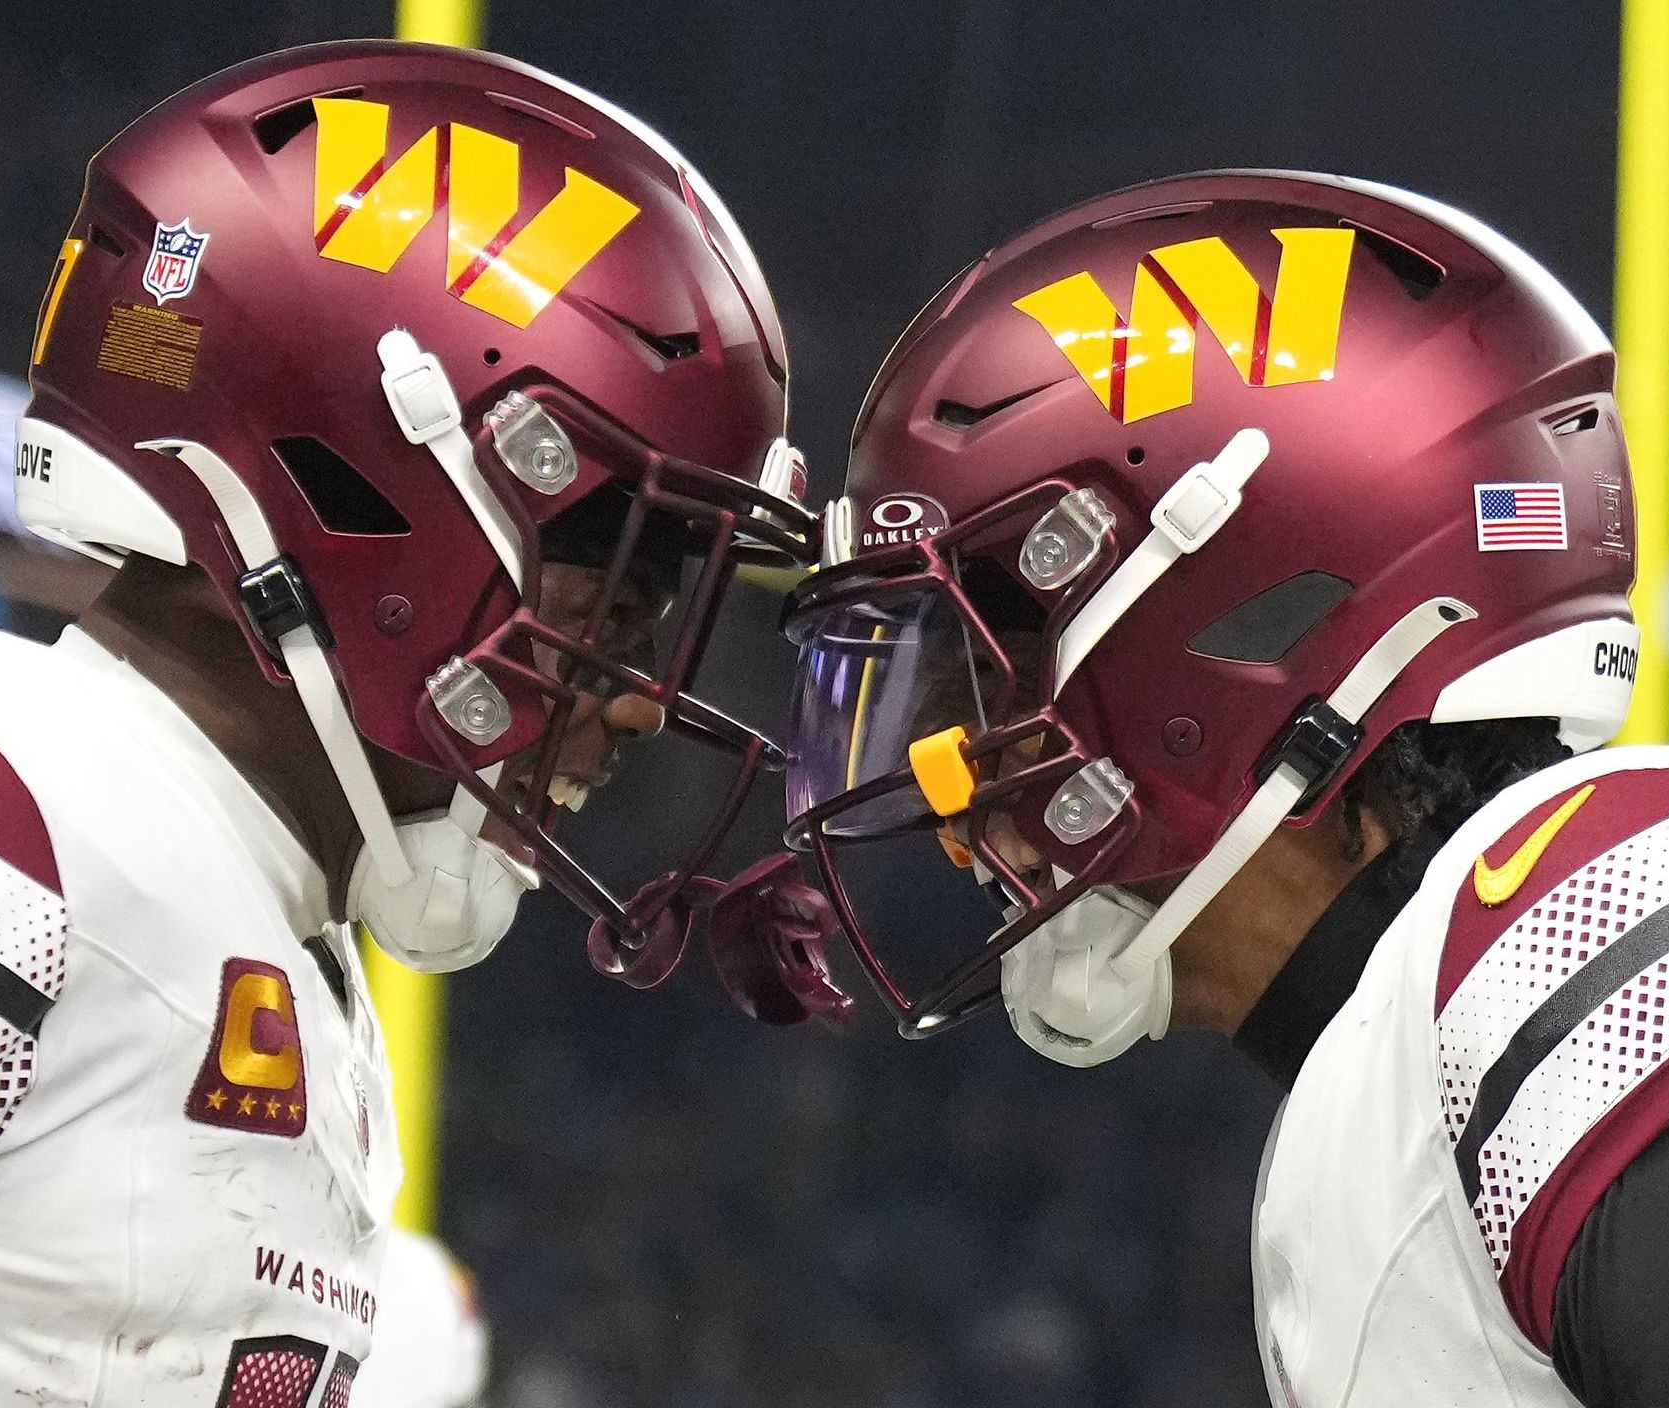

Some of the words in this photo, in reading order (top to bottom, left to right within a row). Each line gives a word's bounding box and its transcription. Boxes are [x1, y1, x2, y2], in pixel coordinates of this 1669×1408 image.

[149, 254, 188, 289] NFL
[16, 442, 53, 483] LOVE
[1593, 641, 1639, 686] CHOO
[219, 973, 300, 1090] C
